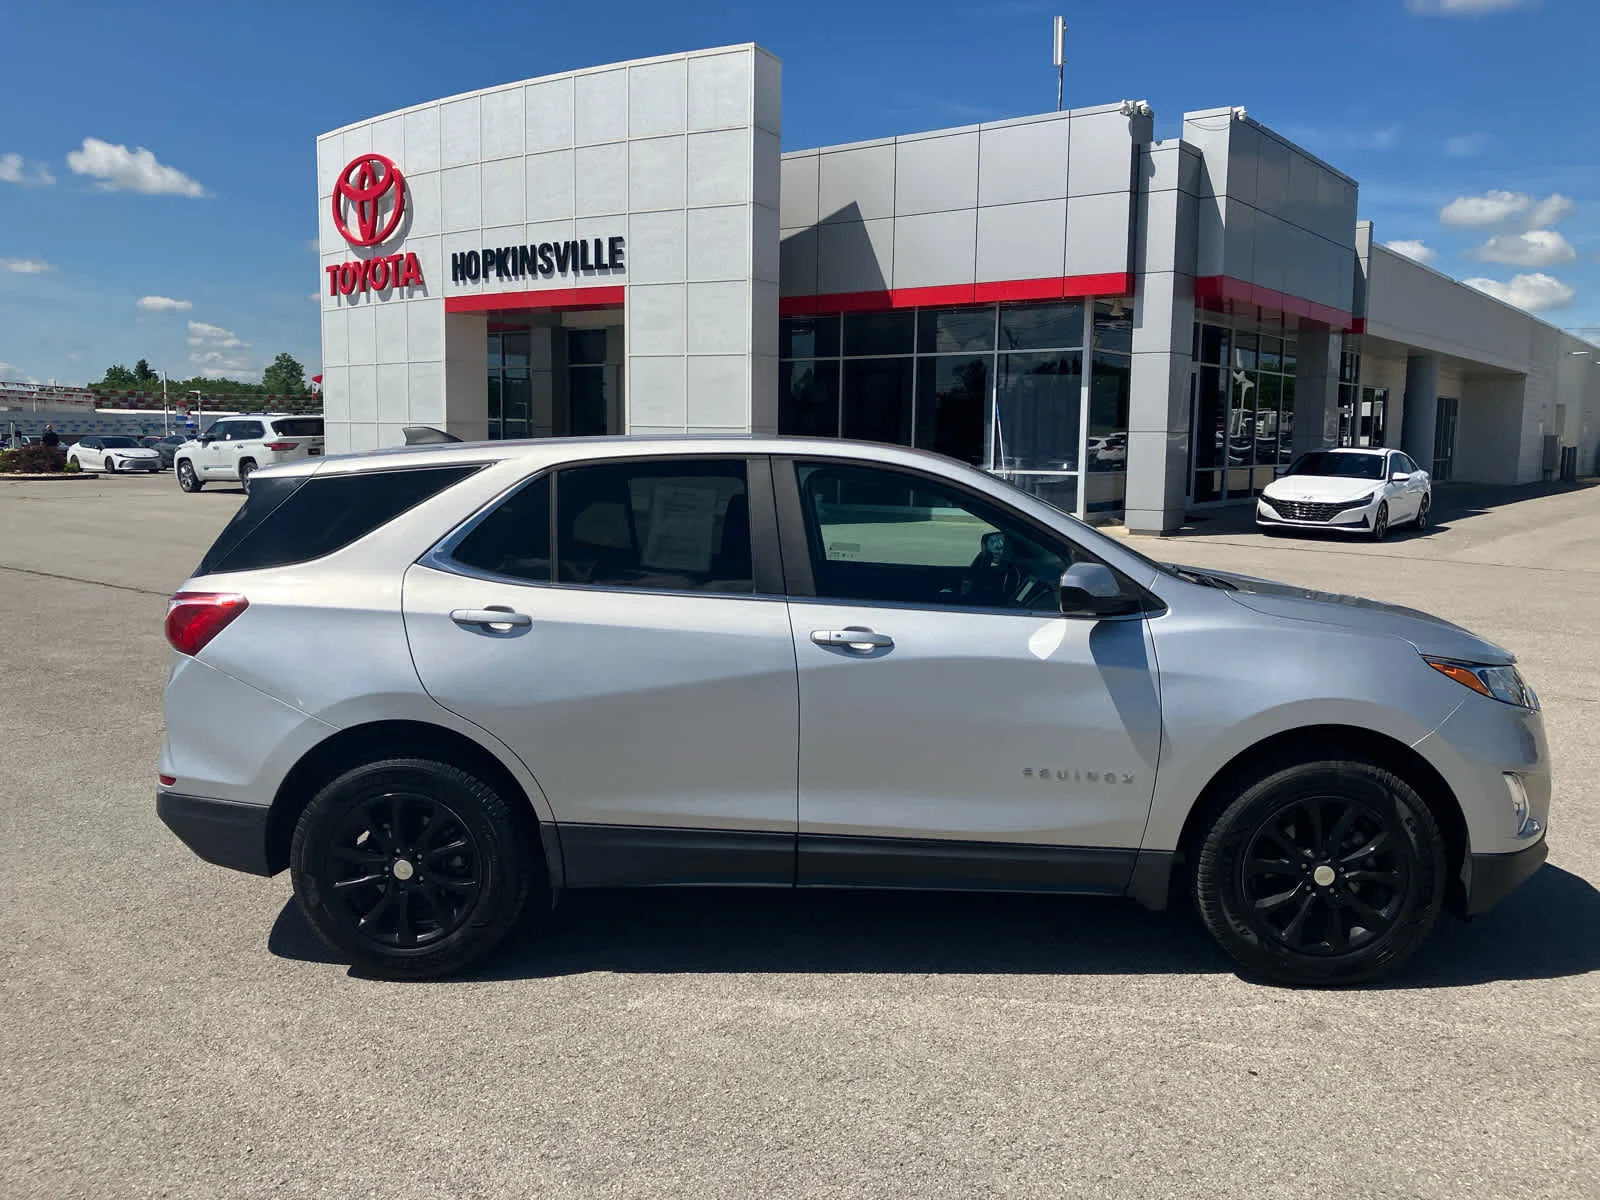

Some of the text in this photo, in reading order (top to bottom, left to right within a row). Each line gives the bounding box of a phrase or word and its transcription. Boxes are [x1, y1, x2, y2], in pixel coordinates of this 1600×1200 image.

[326, 252, 424, 297] TOYOTA
[451, 236, 626, 282] HOPKINSVILLE
[1022, 767, 1135, 785] EQUINOX
